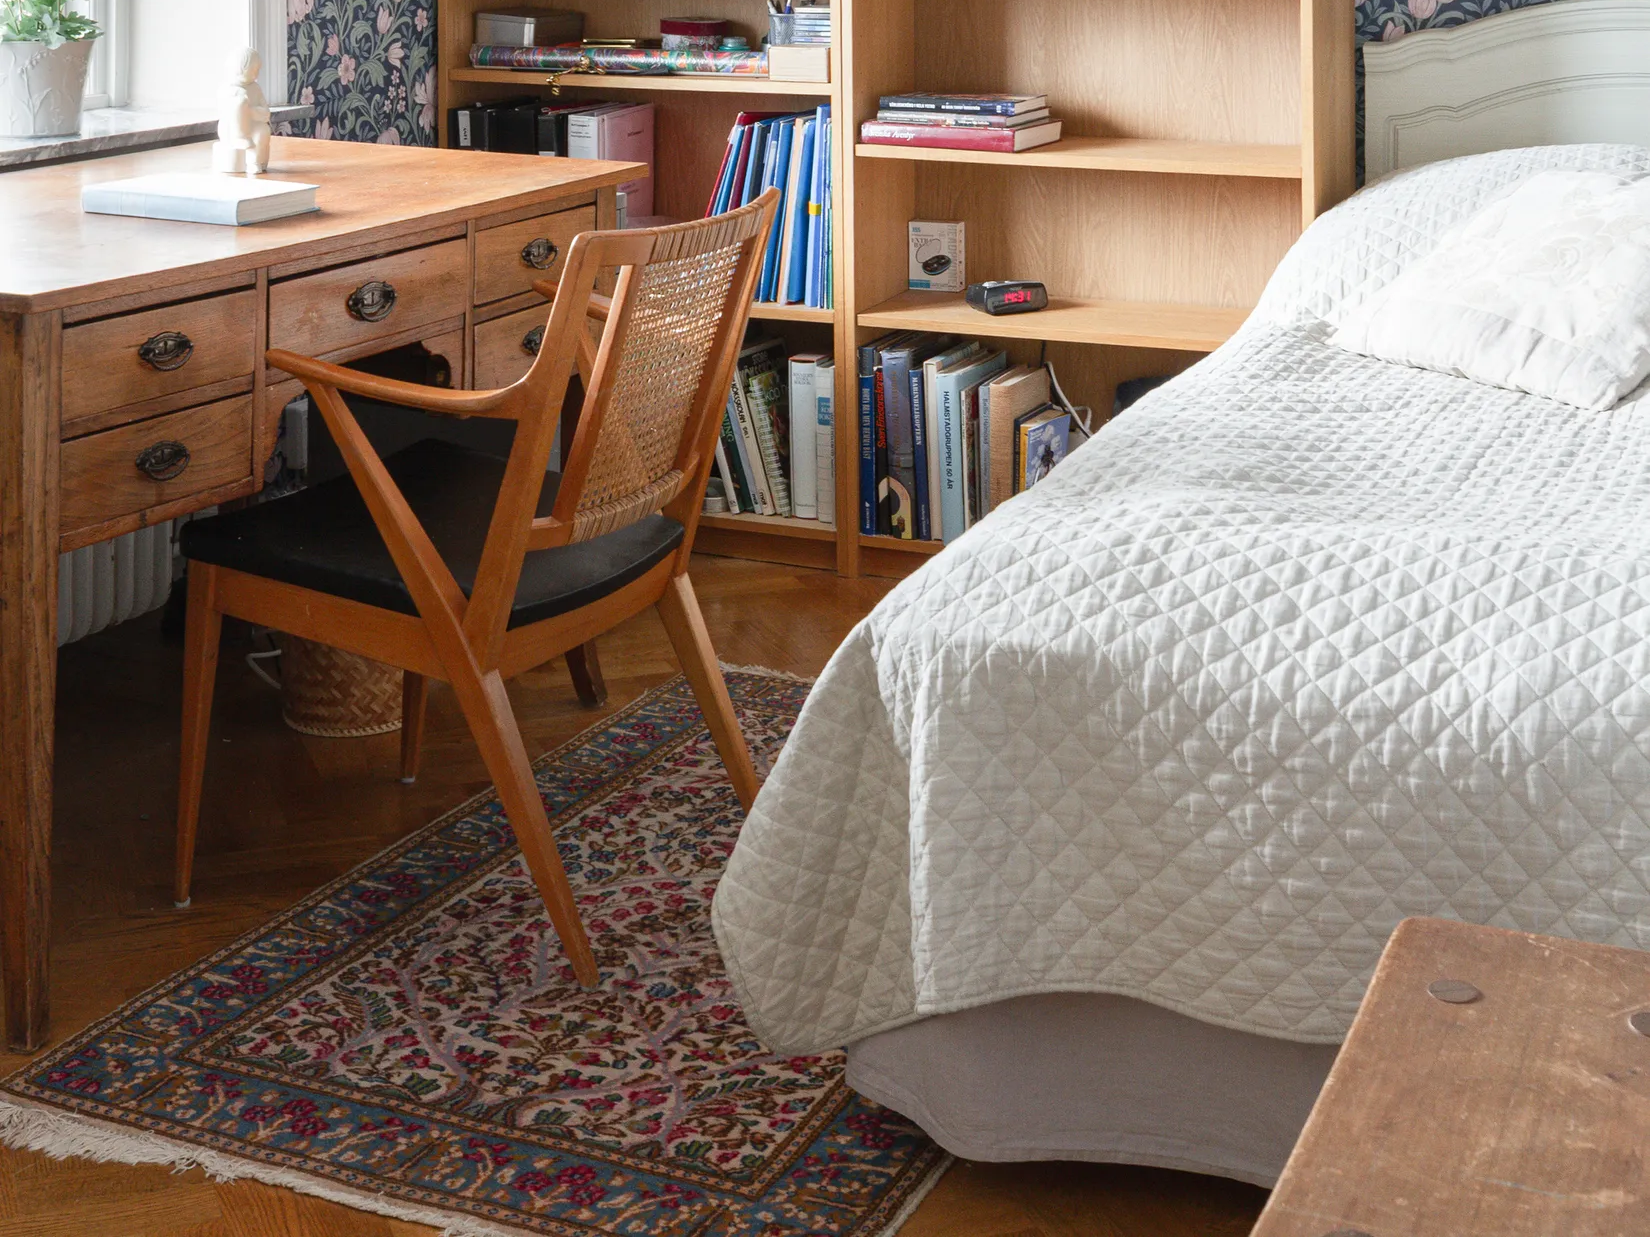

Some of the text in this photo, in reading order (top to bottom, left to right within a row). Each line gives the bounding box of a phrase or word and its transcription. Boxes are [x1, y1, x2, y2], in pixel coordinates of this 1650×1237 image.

[874, 371, 884, 394] konst
[730, 382, 747, 424] KÖKSSKOLAN
[862, 404, 870, 414] BRA
[912, 376, 922, 446] MARINHELIKOPTERN
[862, 415, 871, 426] MEN
[877, 428, 887, 449] Sven
[943, 391, 954, 490] HALMSTADGRUPPEN 50 ÅR
